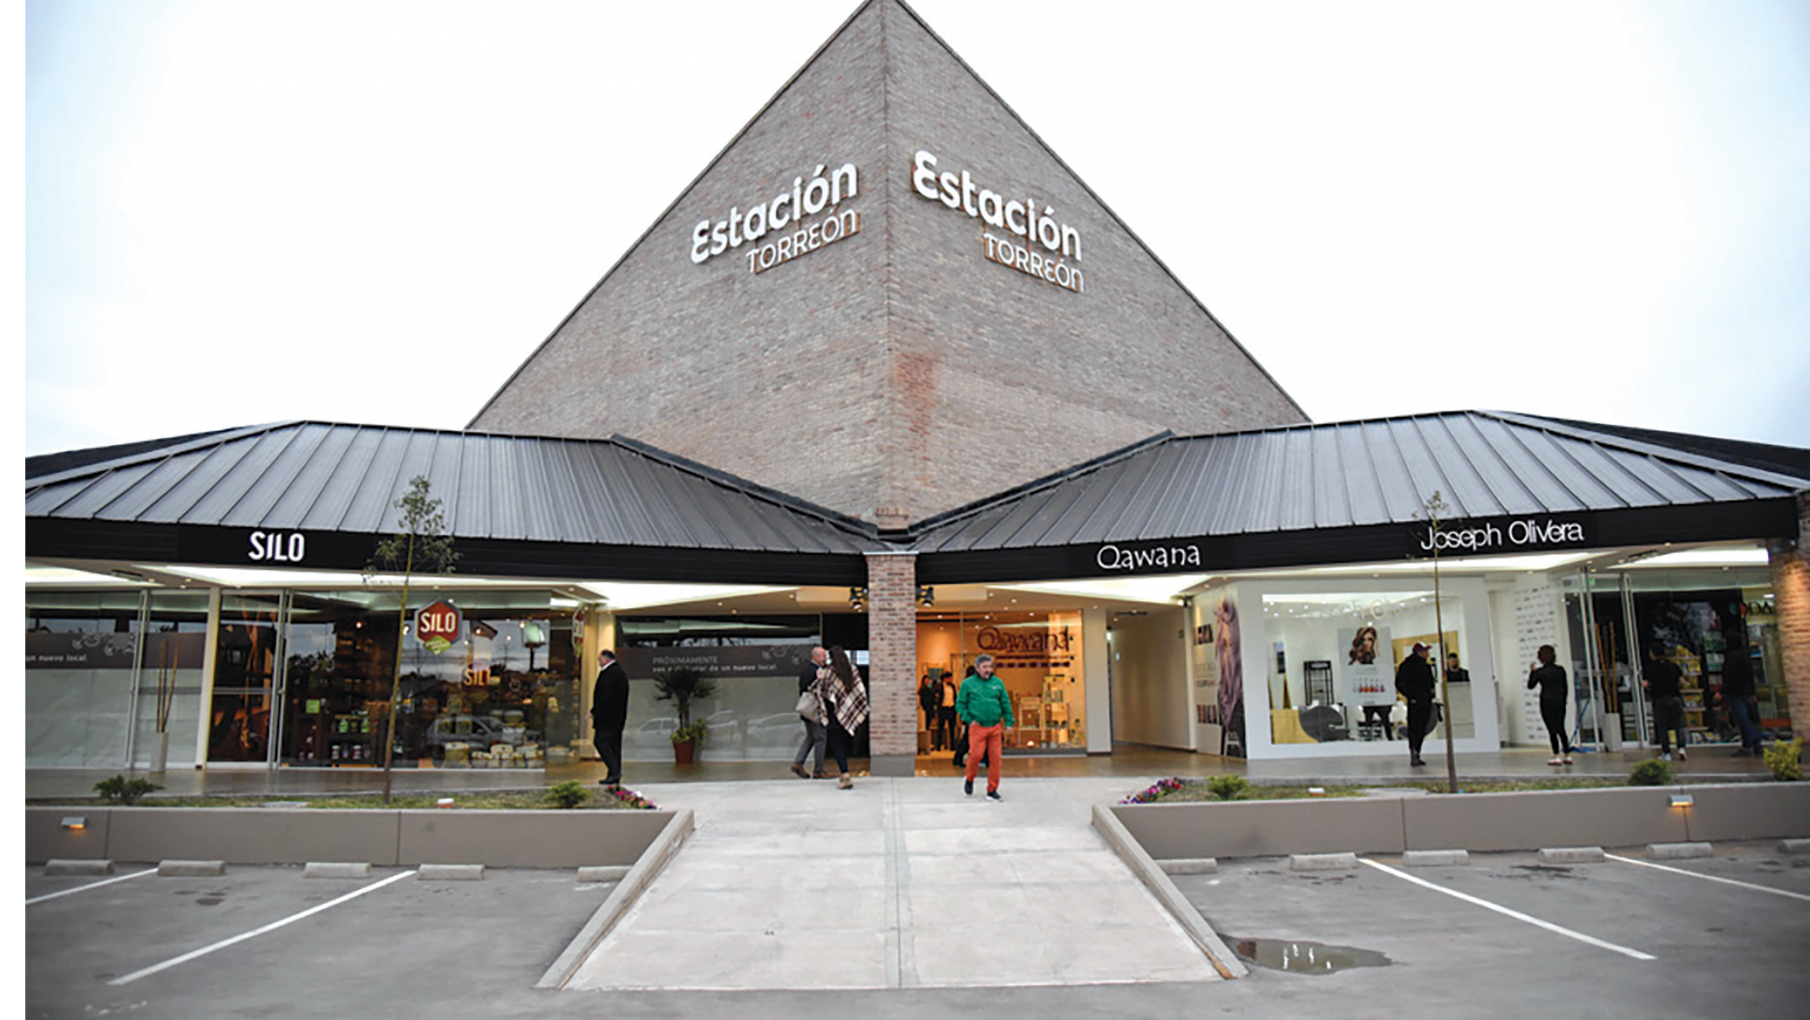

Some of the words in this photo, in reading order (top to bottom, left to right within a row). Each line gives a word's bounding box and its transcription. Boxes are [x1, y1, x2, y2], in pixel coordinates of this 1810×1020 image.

[691, 163, 858, 264] Estación
[911, 149, 1082, 262] Estación
[248, 531, 305, 561] SILO
[1420, 522, 1502, 550] Joseph
[1508, 519, 1585, 544] Olivera
[1097, 545, 1200, 570] Qawana
[420, 612, 456, 633] SILO
